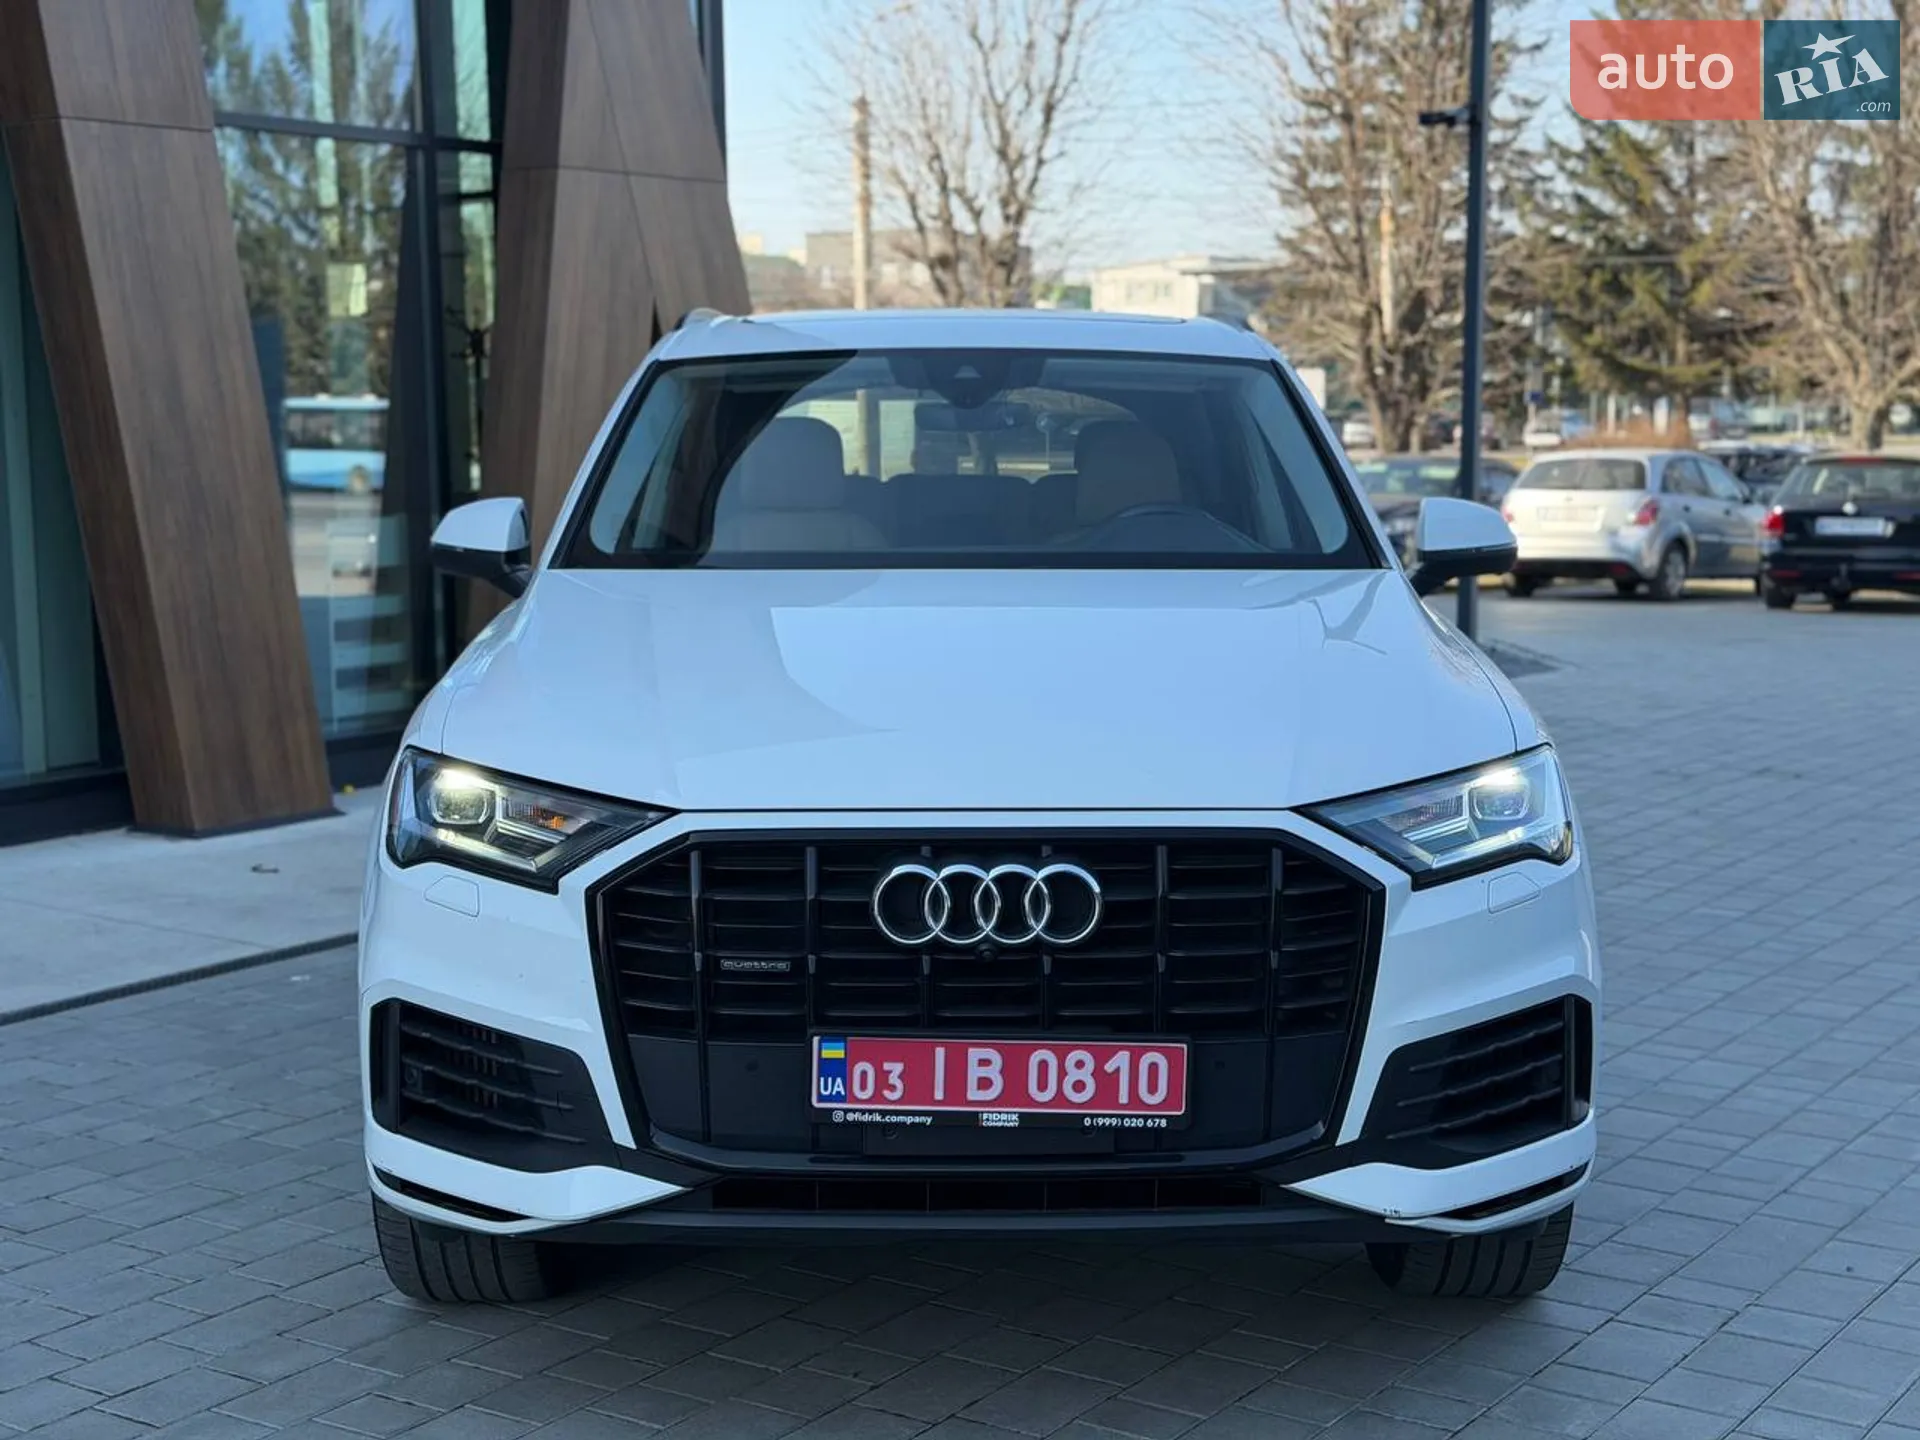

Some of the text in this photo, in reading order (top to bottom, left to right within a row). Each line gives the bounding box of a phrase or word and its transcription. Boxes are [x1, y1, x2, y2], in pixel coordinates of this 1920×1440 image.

[723, 960, 788, 970] quattro
[851, 1060, 906, 1101] 03
[1027, 1048, 1169, 1106] 0810
[819, 1076, 846, 1096] UA
[846, 1111, 933, 1125] @fidrik.company
[982, 1112, 1019, 1121] FIDRIK
[982, 1120, 1019, 1128] COMPANY
[1093, 1117, 1121, 1127] (999)
[1123, 1118, 1144, 1127] 020
[1146, 1118, 1167, 1128] 678
